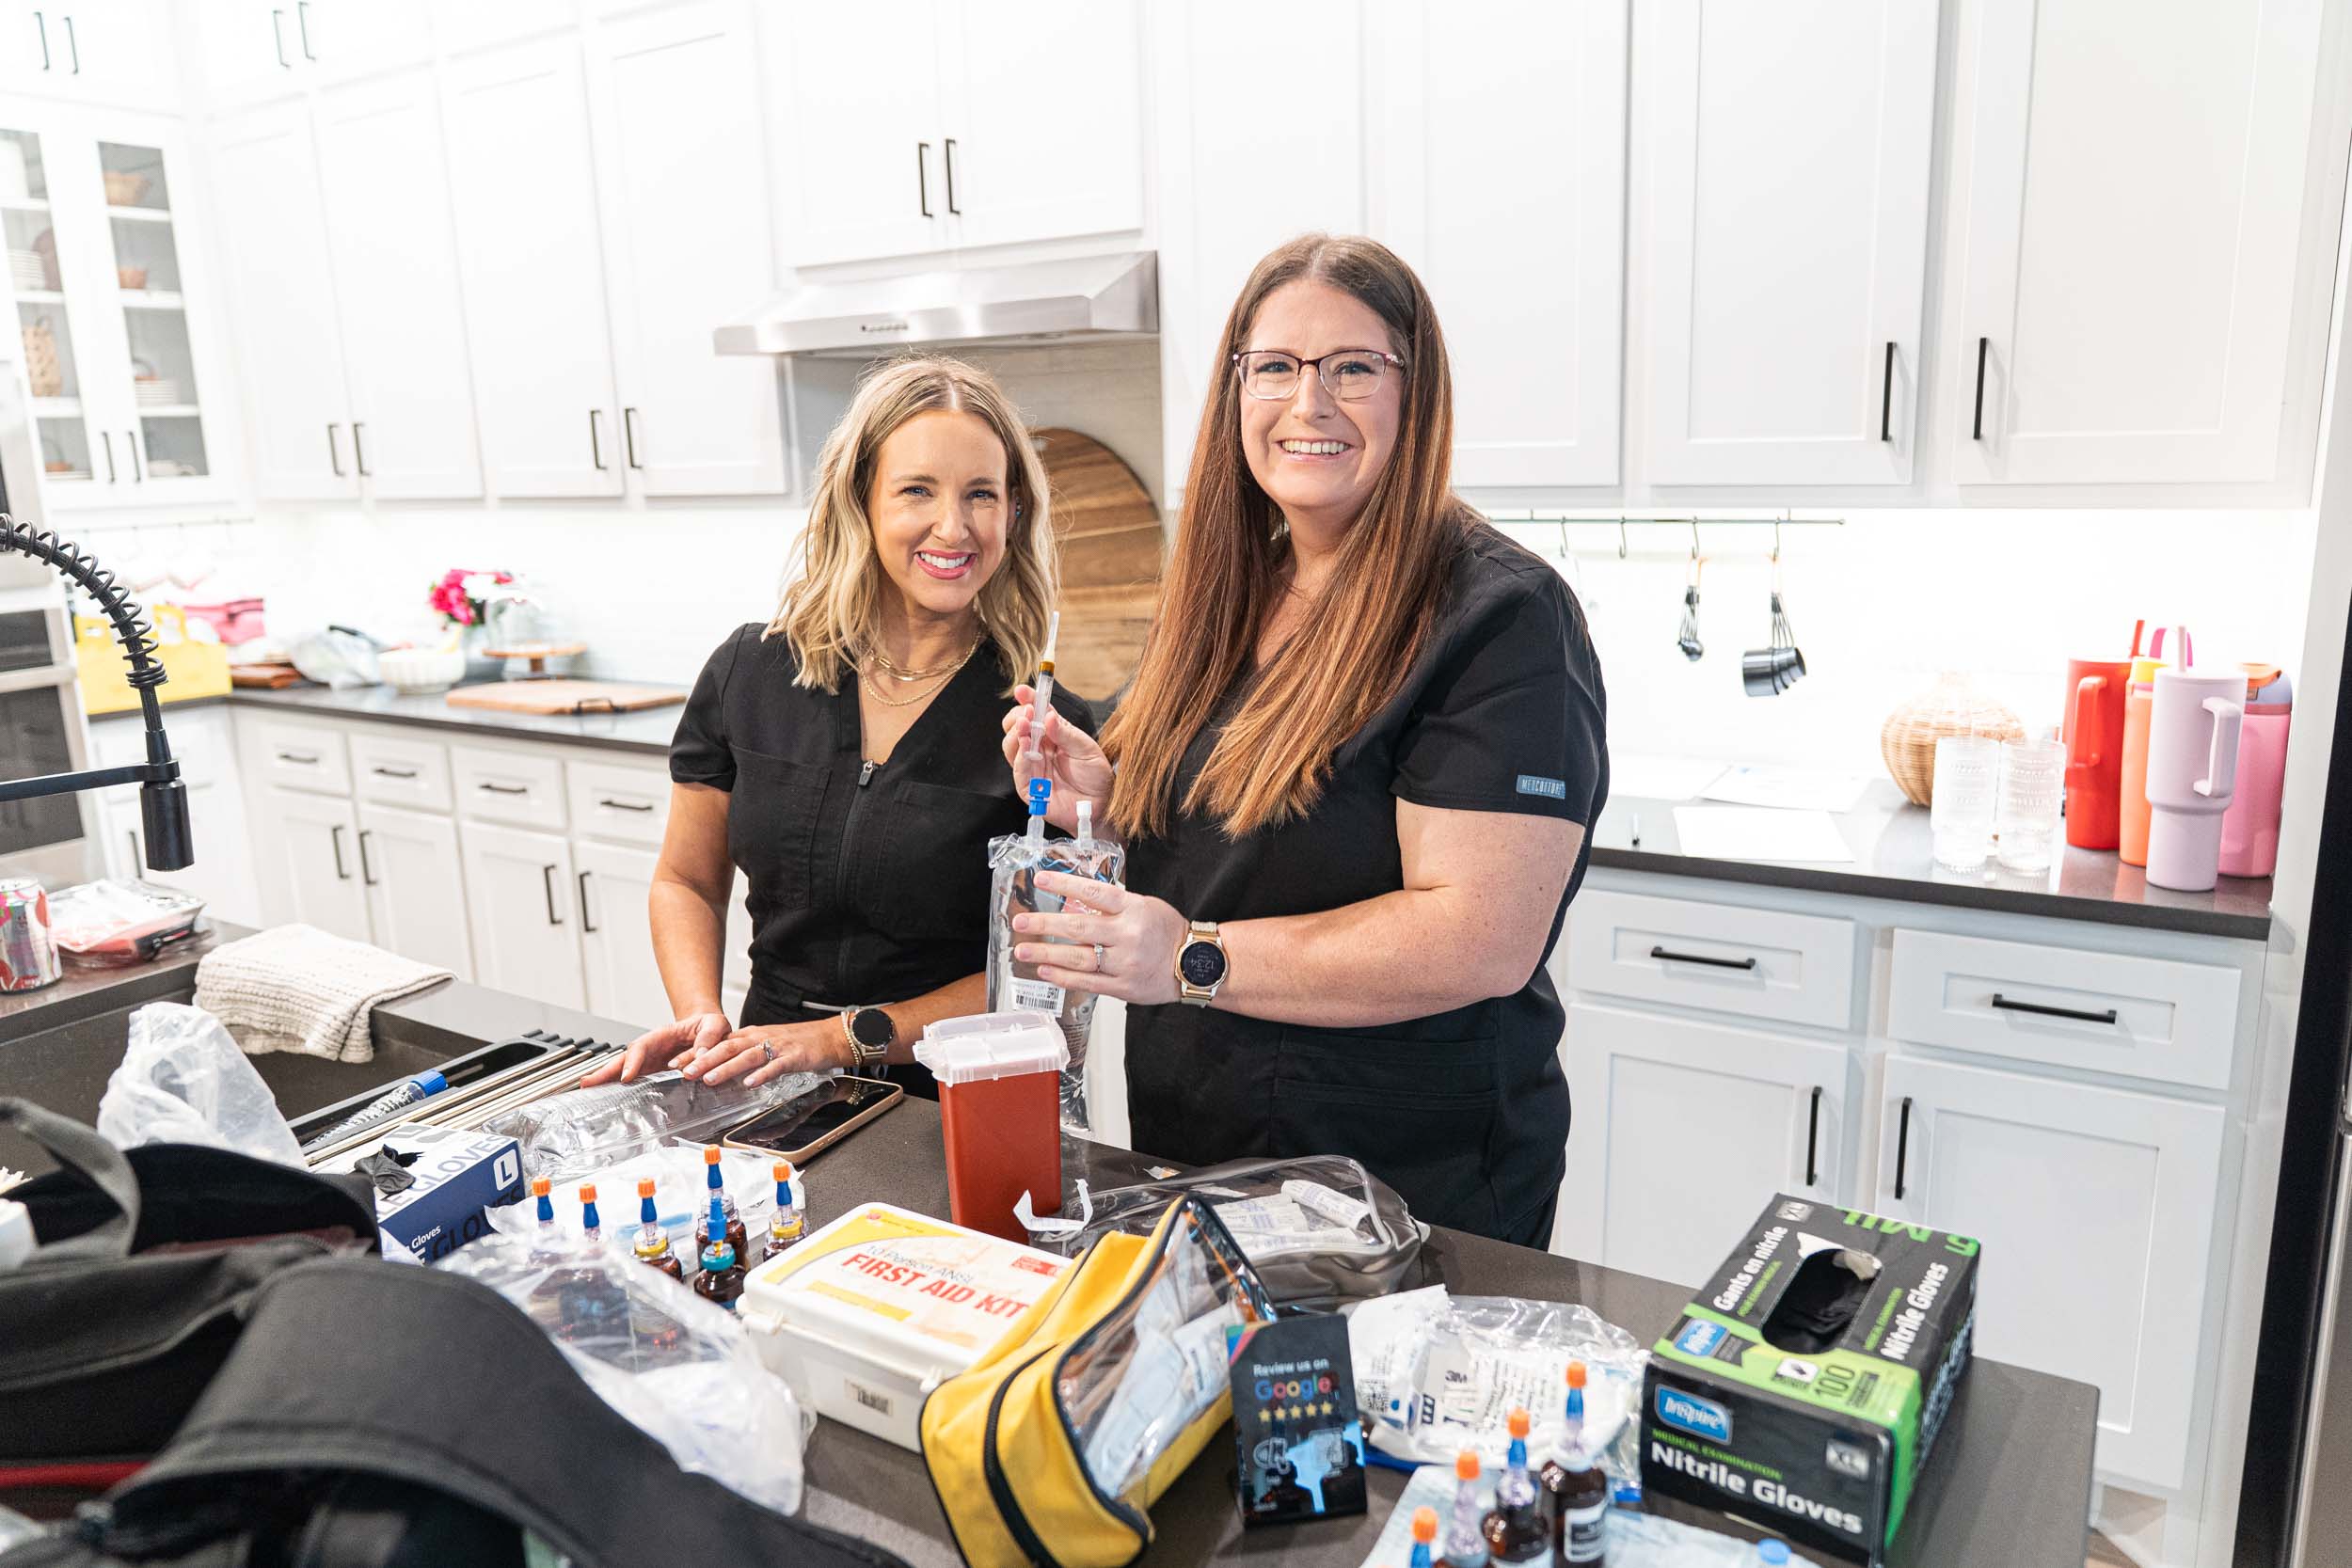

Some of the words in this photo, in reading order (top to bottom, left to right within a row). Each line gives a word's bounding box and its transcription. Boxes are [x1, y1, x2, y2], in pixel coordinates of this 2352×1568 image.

[411, 1225, 441, 1249] Gloves
[842, 1253, 926, 1287] FIRST
[919, 1279, 976, 1303] AID
[974, 1293, 1030, 1319] KIT
[1712, 1272, 1754, 1311] Gants
[1742, 1258, 1765, 1275] en
[1754, 1226, 1788, 1260] nitrile
[1880, 1307, 1926, 1361] Nitrile
[1906, 1261, 1949, 1310] Gloves
[1252, 1362, 1295, 1377] Review
[1296, 1360, 1311, 1371] us
[1312, 1358, 1329, 1370] on
[1254, 1373, 1332, 1401] Google
[1813, 1364, 1856, 1399] 100
[1651, 1441, 1747, 1495] Nitrile
[1753, 1478, 1864, 1534] Gloves
